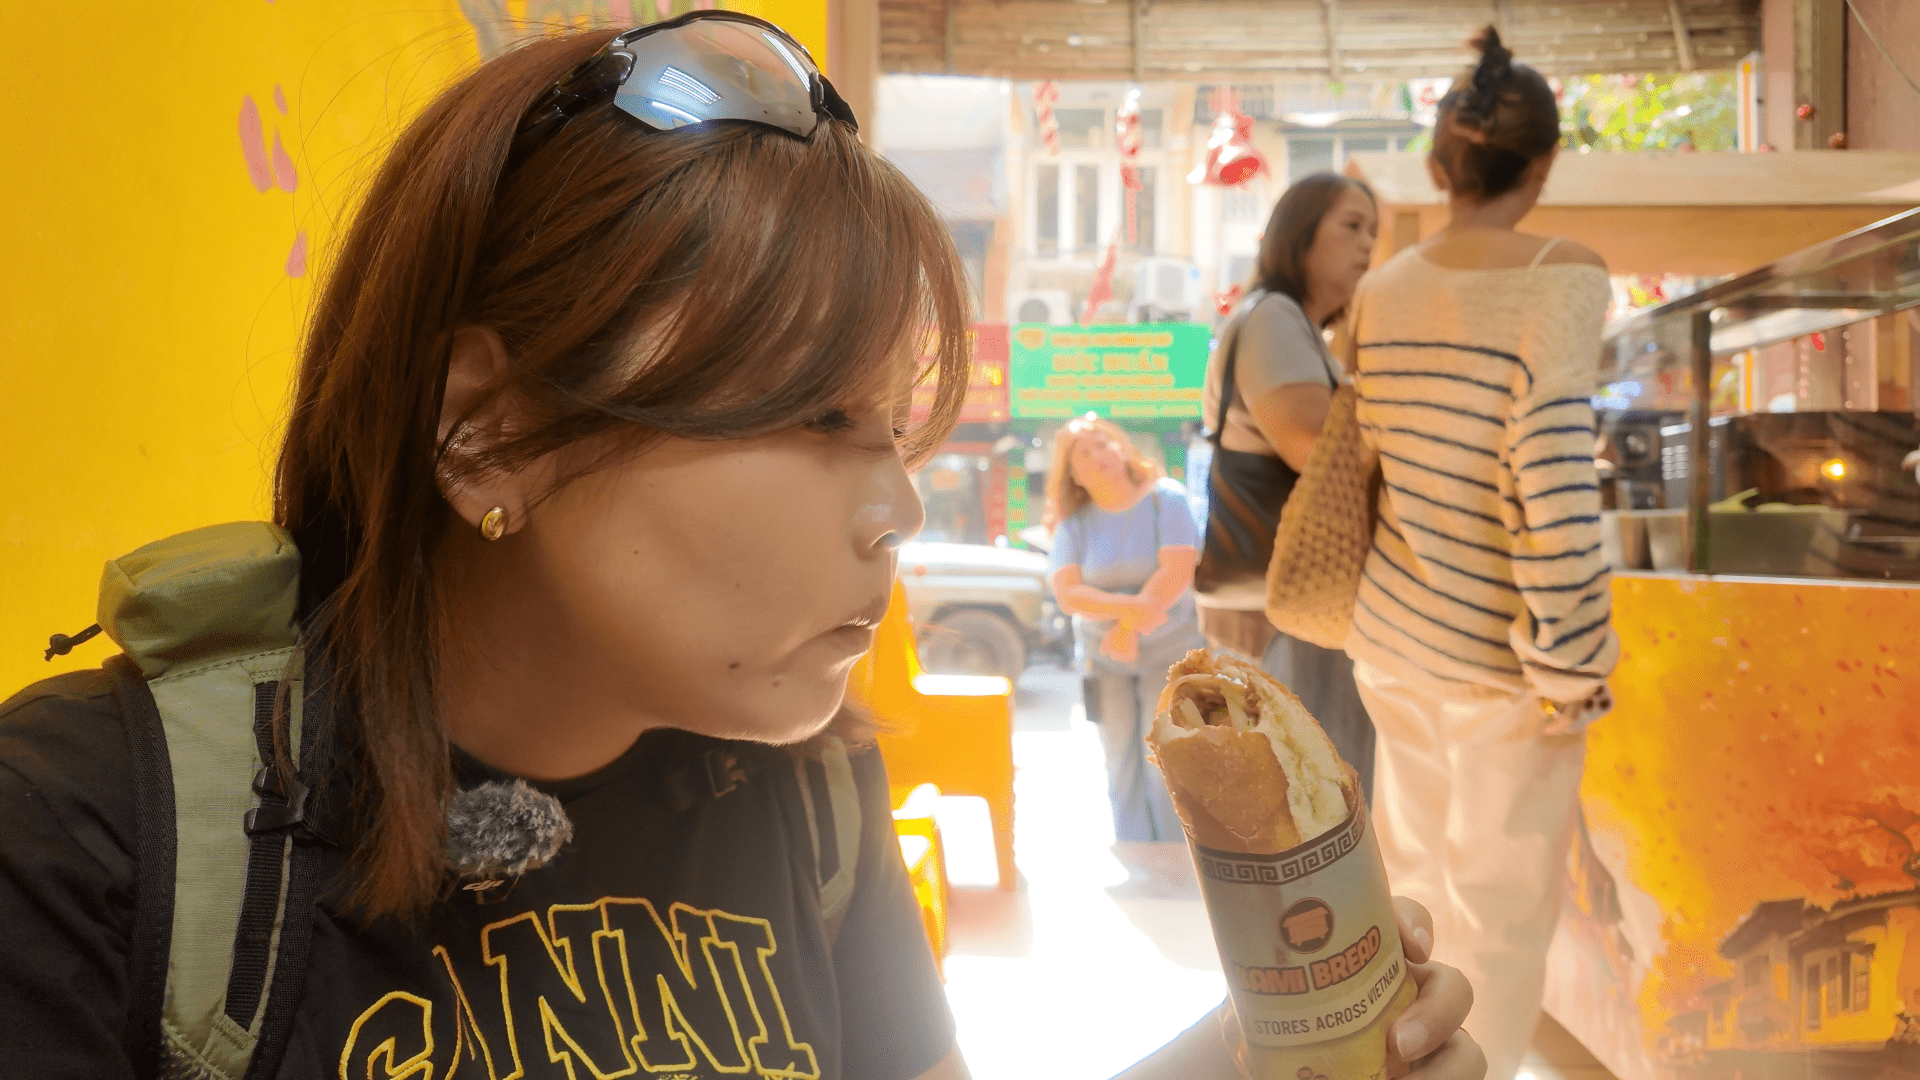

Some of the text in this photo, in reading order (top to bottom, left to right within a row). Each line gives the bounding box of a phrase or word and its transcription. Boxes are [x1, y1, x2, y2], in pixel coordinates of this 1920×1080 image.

[1309, 925, 1381, 991] BREAD
[1254, 1018, 1311, 1036] STORES
[1316, 999, 1368, 1031] ACROSS
[1367, 960, 1400, 1005] VIETNAM
